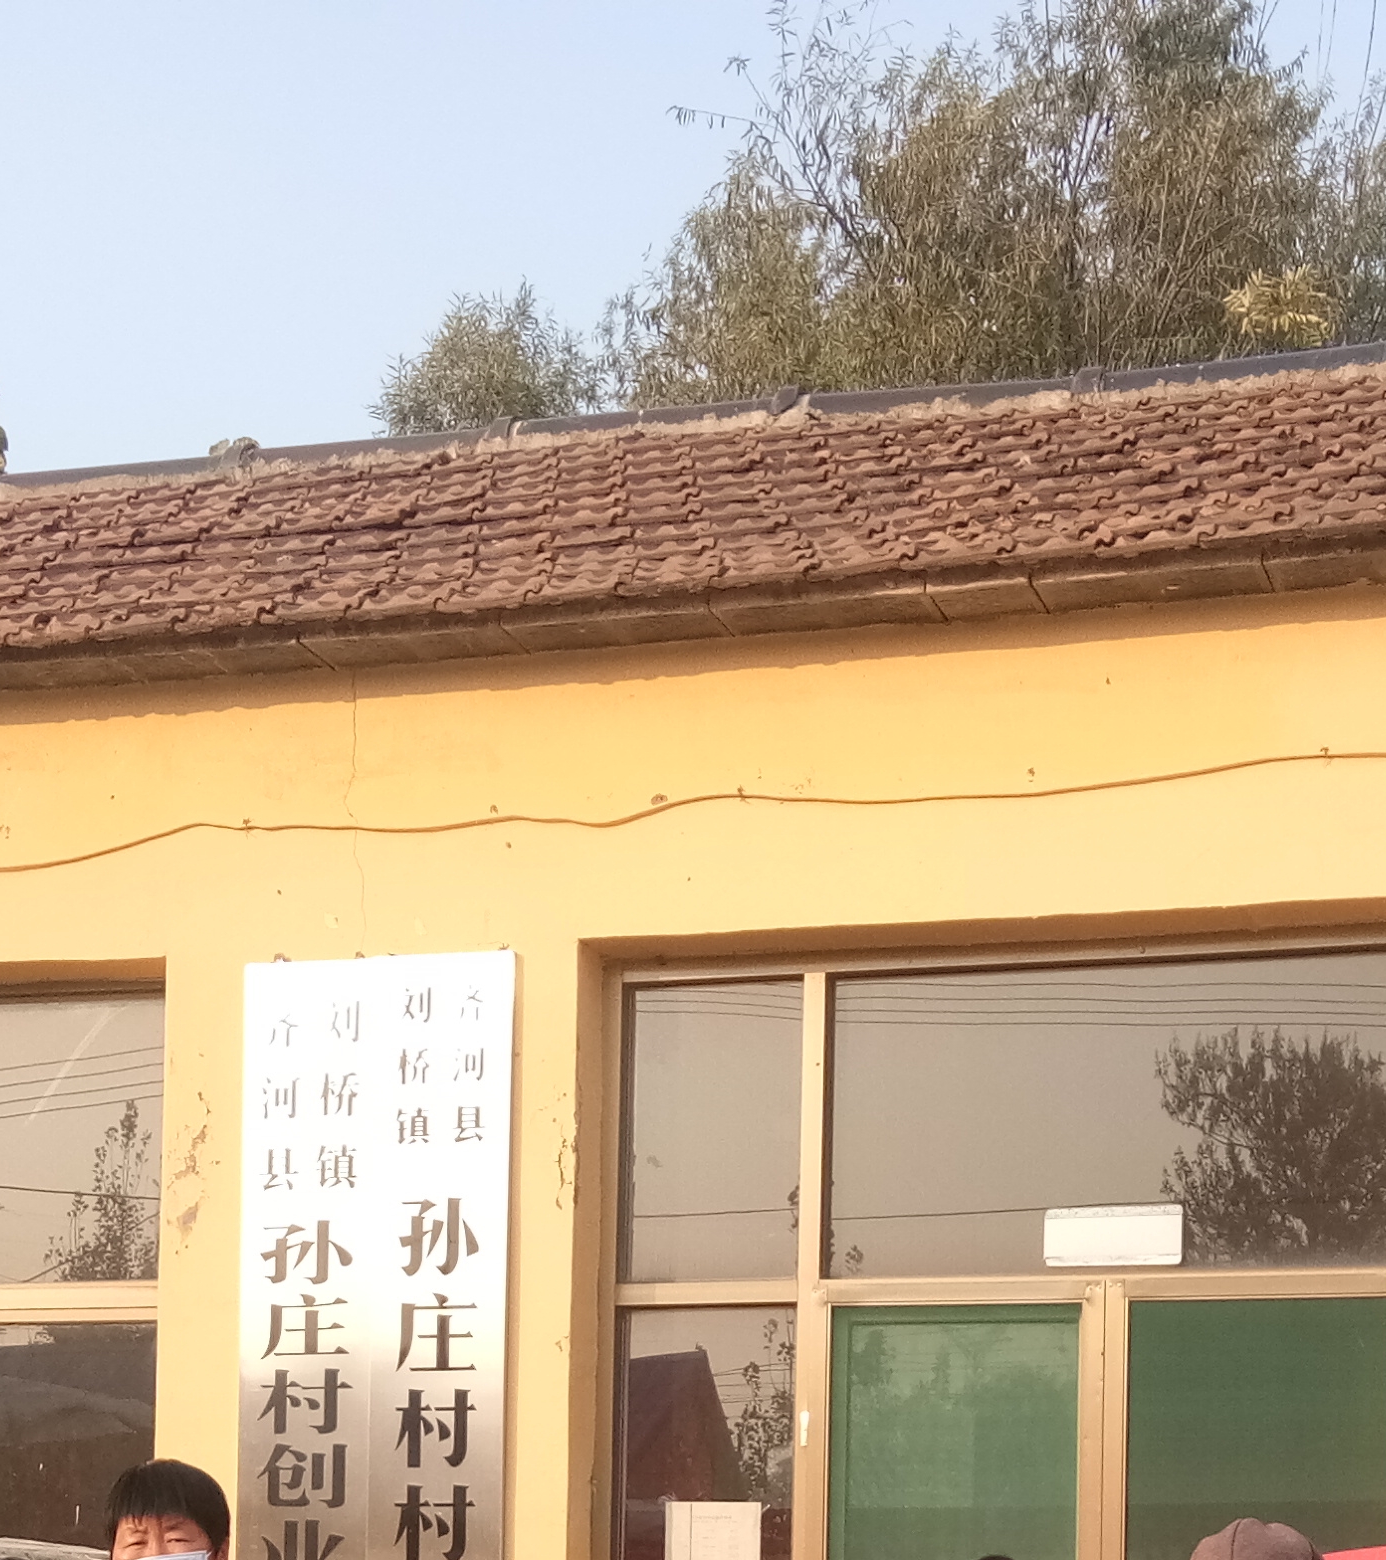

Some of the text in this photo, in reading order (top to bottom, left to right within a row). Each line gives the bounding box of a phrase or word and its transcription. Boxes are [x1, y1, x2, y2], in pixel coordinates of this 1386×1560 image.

[315, 1000, 361, 1189] 刘桥镇
[395, 986, 432, 1145] 刘桥镇
[452, 984, 486, 1143] 齐河县
